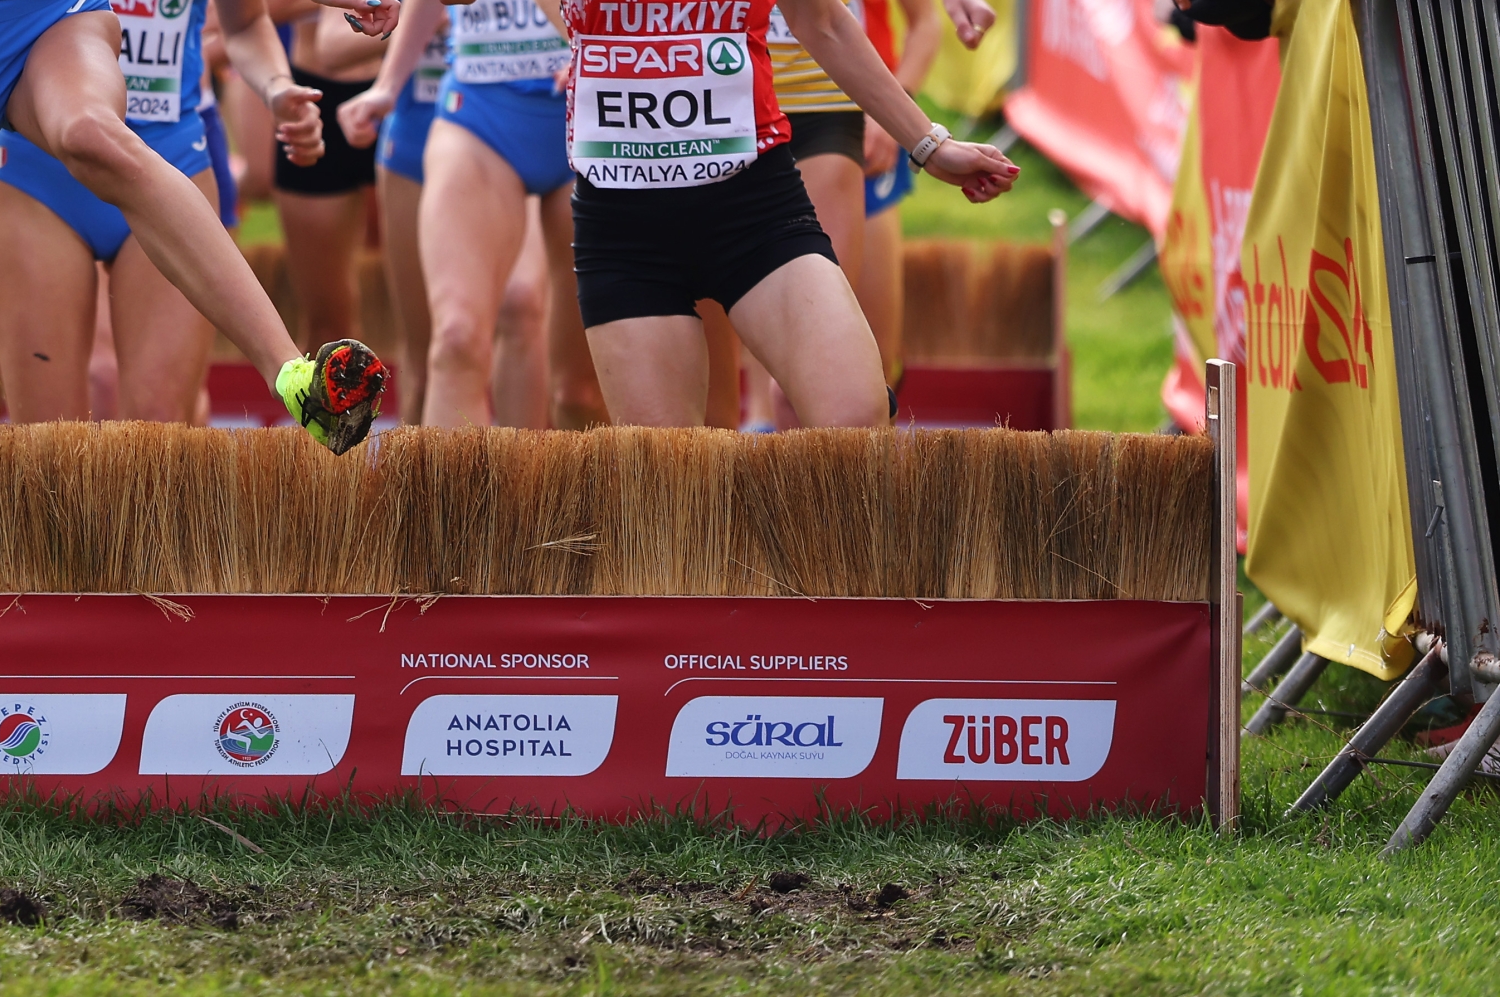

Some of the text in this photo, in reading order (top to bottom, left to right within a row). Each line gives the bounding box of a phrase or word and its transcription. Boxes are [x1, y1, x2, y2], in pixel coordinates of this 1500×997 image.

[583, 43, 701, 74] SPAR
[128, 96, 171, 115] 2024
[596, 88, 732, 130] EROL
[612, 143, 617, 156] I
[620, 143, 654, 157] RUN
[586, 159, 747, 183] ANTALYA 2024
[400, 653, 590, 669] NATIONAL SPONSOR
[664, 654, 849, 671] OFFICIAL SUPPLIERS
[447, 714, 572, 731] ANATOLIA
[446, 739, 573, 757] HOSPITAL
[725, 750, 825, 761] DOĞAL KAYNAK SUYU
